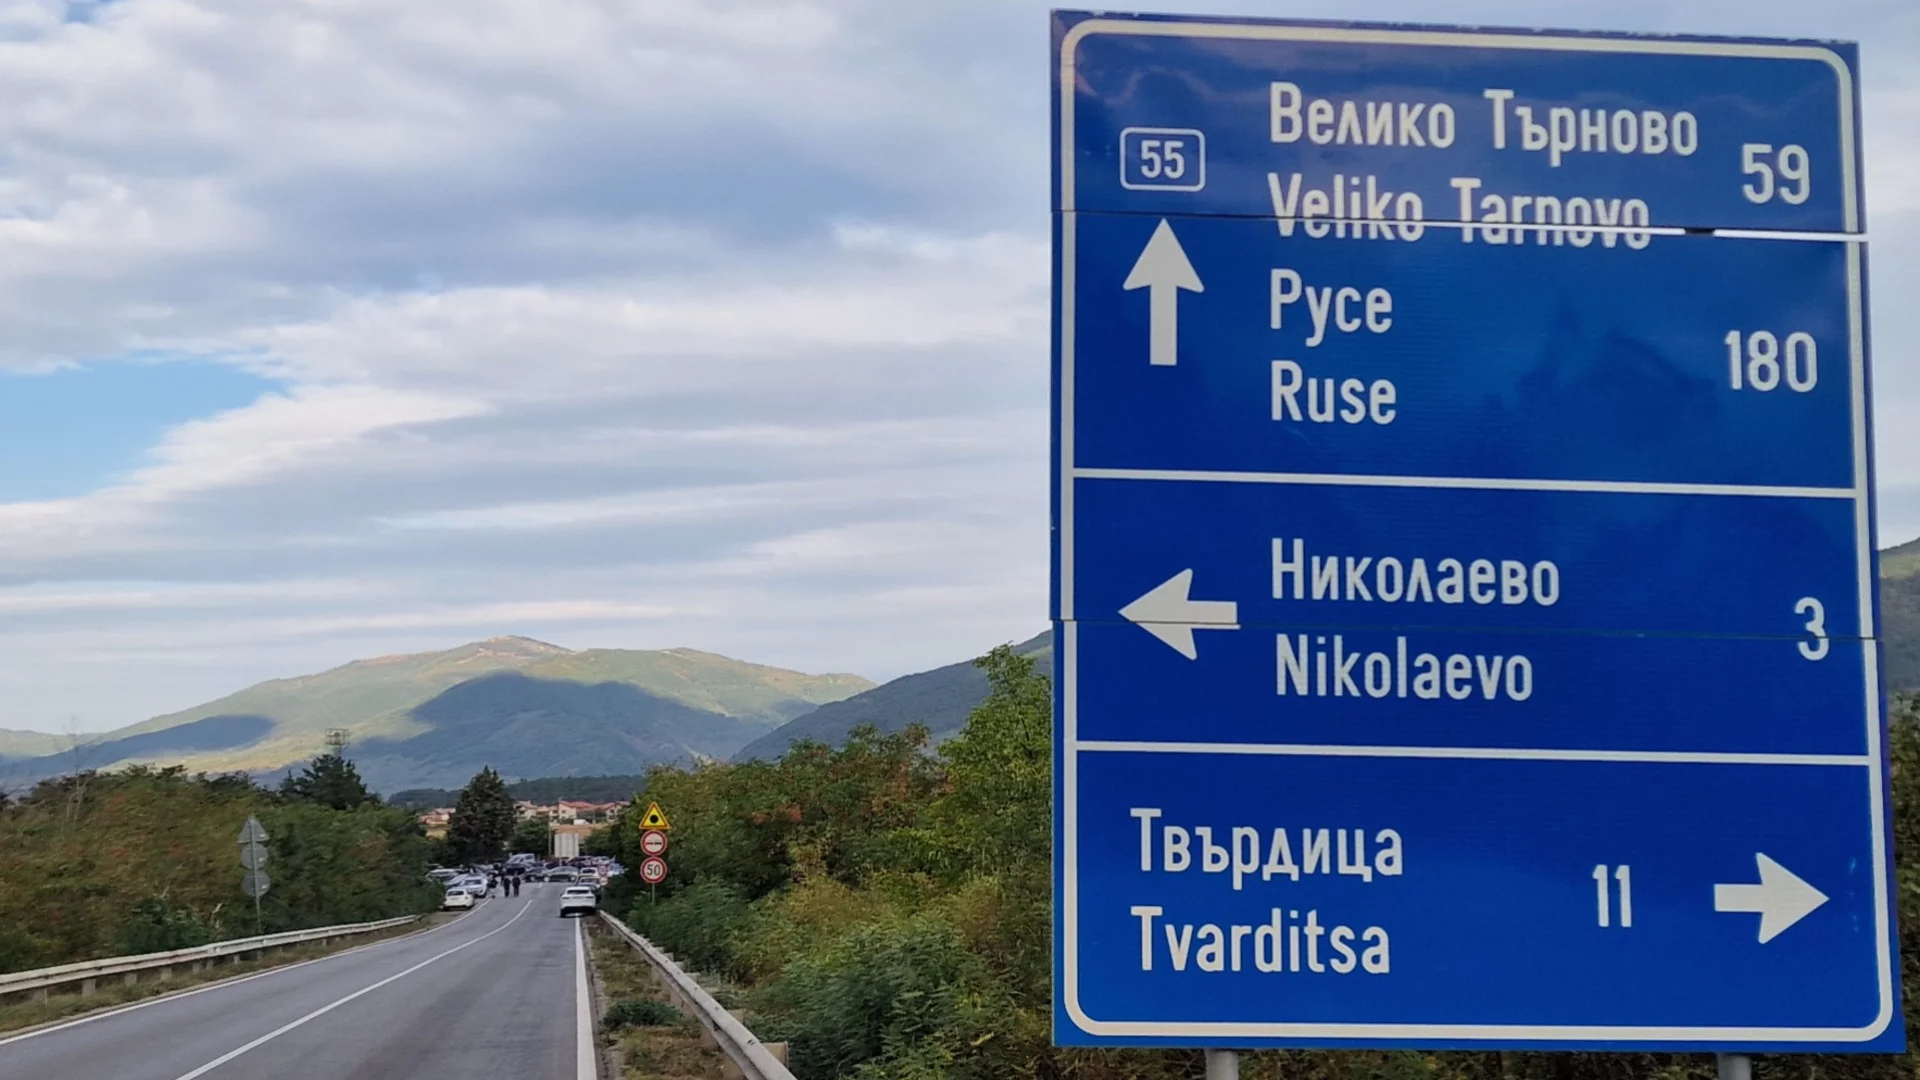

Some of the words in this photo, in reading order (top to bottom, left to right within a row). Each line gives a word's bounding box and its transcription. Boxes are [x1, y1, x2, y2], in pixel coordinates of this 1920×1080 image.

[1270, 82, 1455, 149] Велико
[1484, 89, 1698, 167] Търново
[1139, 140, 1185, 180] 55
[1741, 143, 1810, 205] 59
[1268, 173, 1424, 241] Veliko
[1450, 177, 1651, 249] Tarnovo
[1271, 268, 1393, 347] Русе
[1271, 360, 1397, 424] Ruse
[1725, 330, 1818, 393] 180
[1272, 538, 1559, 606] Николаево
[1795, 597, 1829, 661] 3
[1276, 633, 1533, 701] Nikolaevo
[647, 864, 660, 875] 50
[1130, 808, 1403, 890] Твърдица
[1592, 864, 1632, 928] 11
[1130, 905, 1391, 974] Tvarditsa
